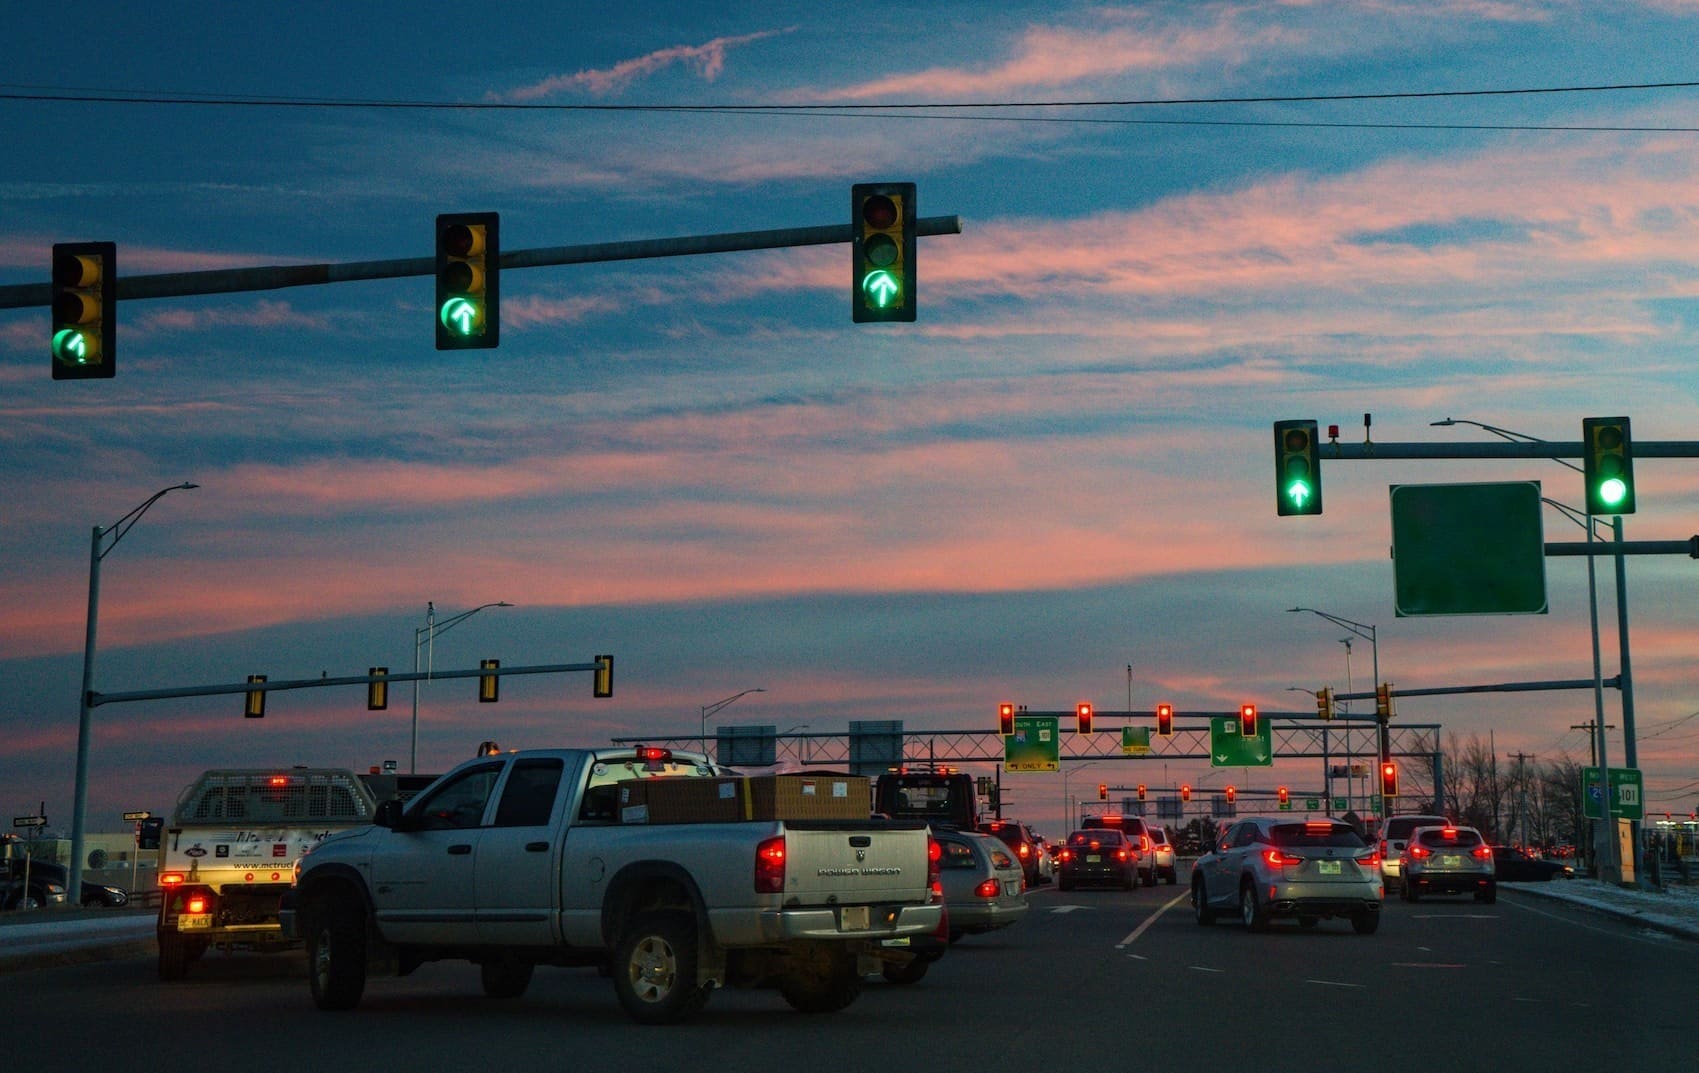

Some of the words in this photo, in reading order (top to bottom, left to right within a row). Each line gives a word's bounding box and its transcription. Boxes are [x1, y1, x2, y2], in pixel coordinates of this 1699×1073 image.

[1621, 789, 1636, 801] 101
[817, 868, 859, 876] POWER
[861, 868, 901, 876] WAGON
